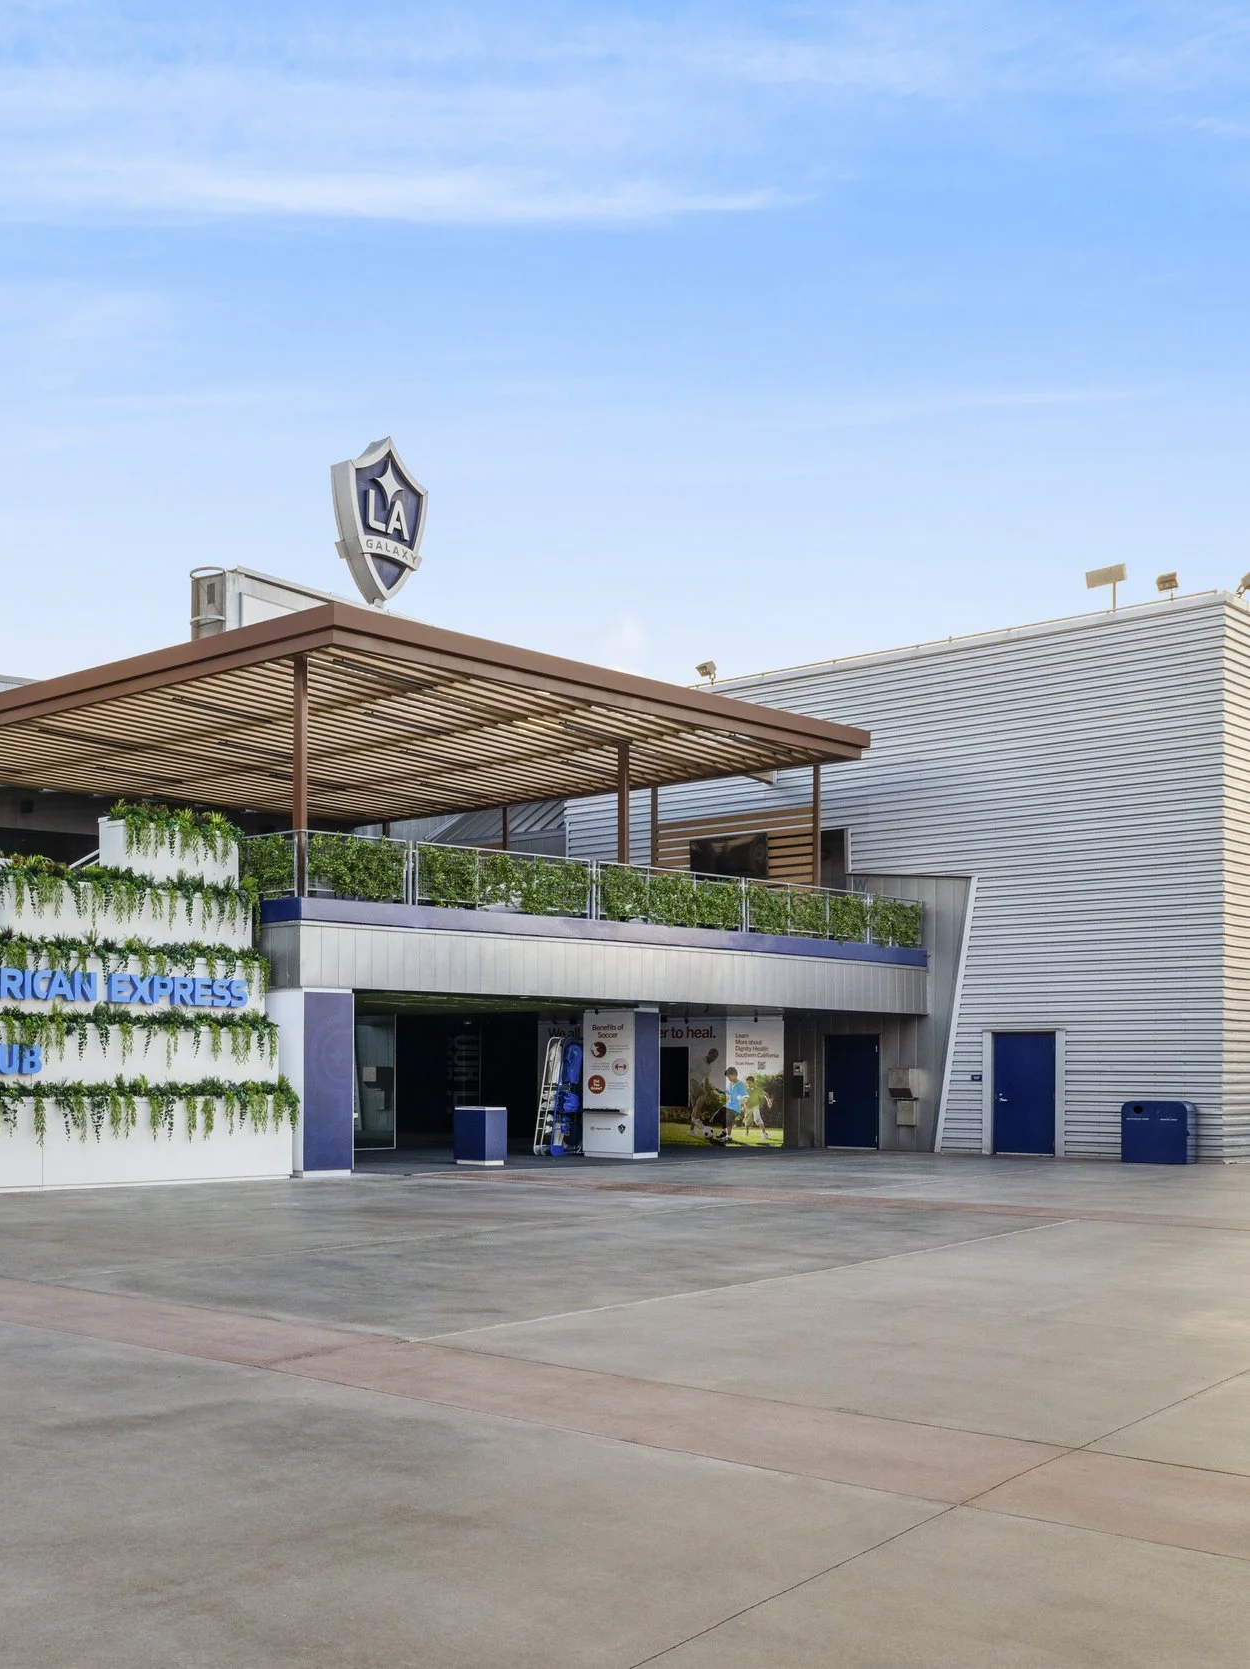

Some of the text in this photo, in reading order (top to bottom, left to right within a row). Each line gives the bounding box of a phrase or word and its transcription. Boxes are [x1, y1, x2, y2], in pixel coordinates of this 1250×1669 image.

[367, 488, 410, 541] LA
[366, 539, 417, 563] GALAXY
[108, 972, 250, 1008] EXPRESS
[671, 1027, 684, 1039] to
[686, 1025, 717, 1039] heal.
